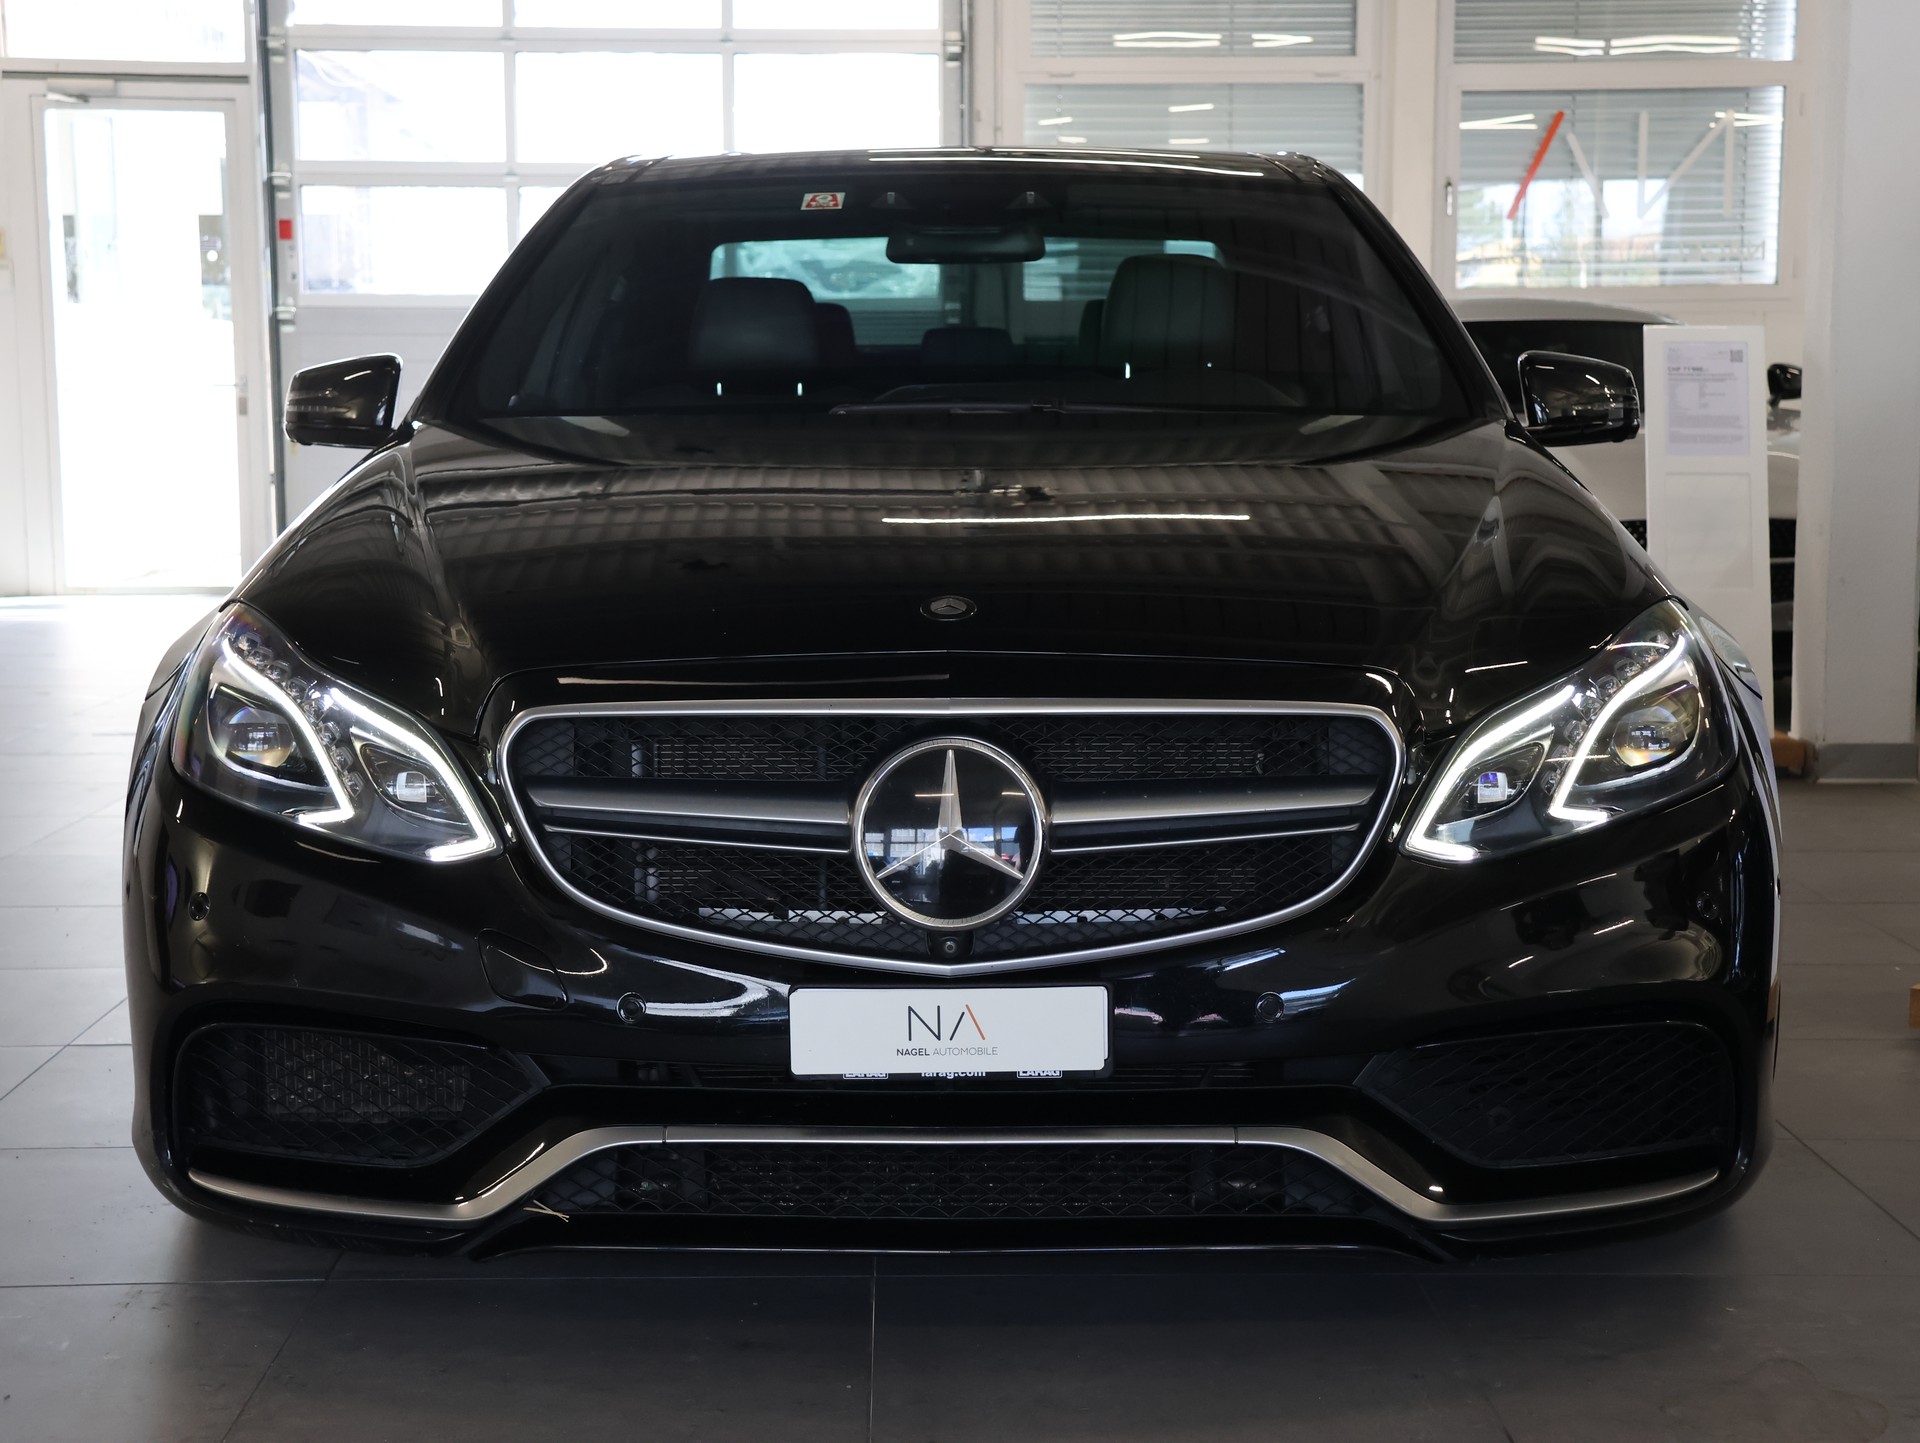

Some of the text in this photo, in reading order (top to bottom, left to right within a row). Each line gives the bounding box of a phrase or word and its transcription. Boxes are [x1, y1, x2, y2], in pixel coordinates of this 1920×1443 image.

[908, 1004, 986, 1041] NA
[896, 1046, 998, 1056] NAGEL AUTOMOBILE
